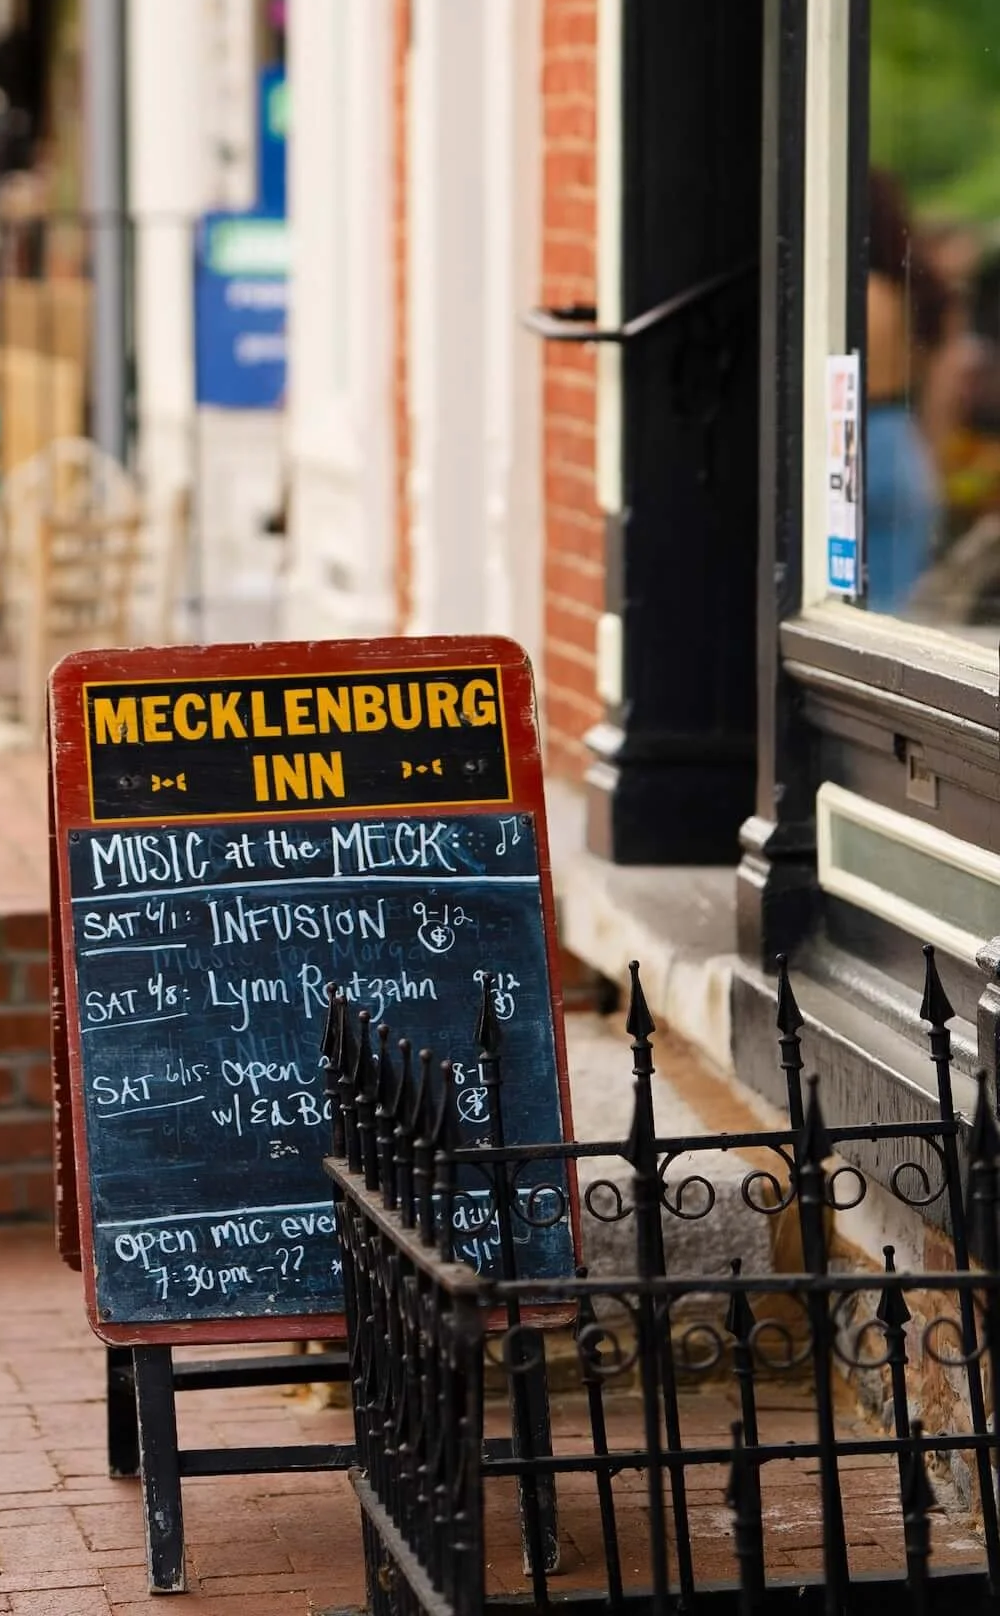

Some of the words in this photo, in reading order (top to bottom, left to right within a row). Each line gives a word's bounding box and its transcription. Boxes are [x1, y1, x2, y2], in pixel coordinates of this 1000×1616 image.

[95, 679, 496, 745] MECKLENBURG
[254, 751, 345, 801] INN
[91, 831, 210, 889] MUSIC
[225, 834, 255, 868] at
[264, 830, 320, 868] the
[84, 912, 140, 939] SAT
[208, 896, 385, 945] INFUSION
[86, 990, 137, 1021] SAT
[208, 971, 290, 1032] Lynn
[93, 1074, 154, 1105] SAT
